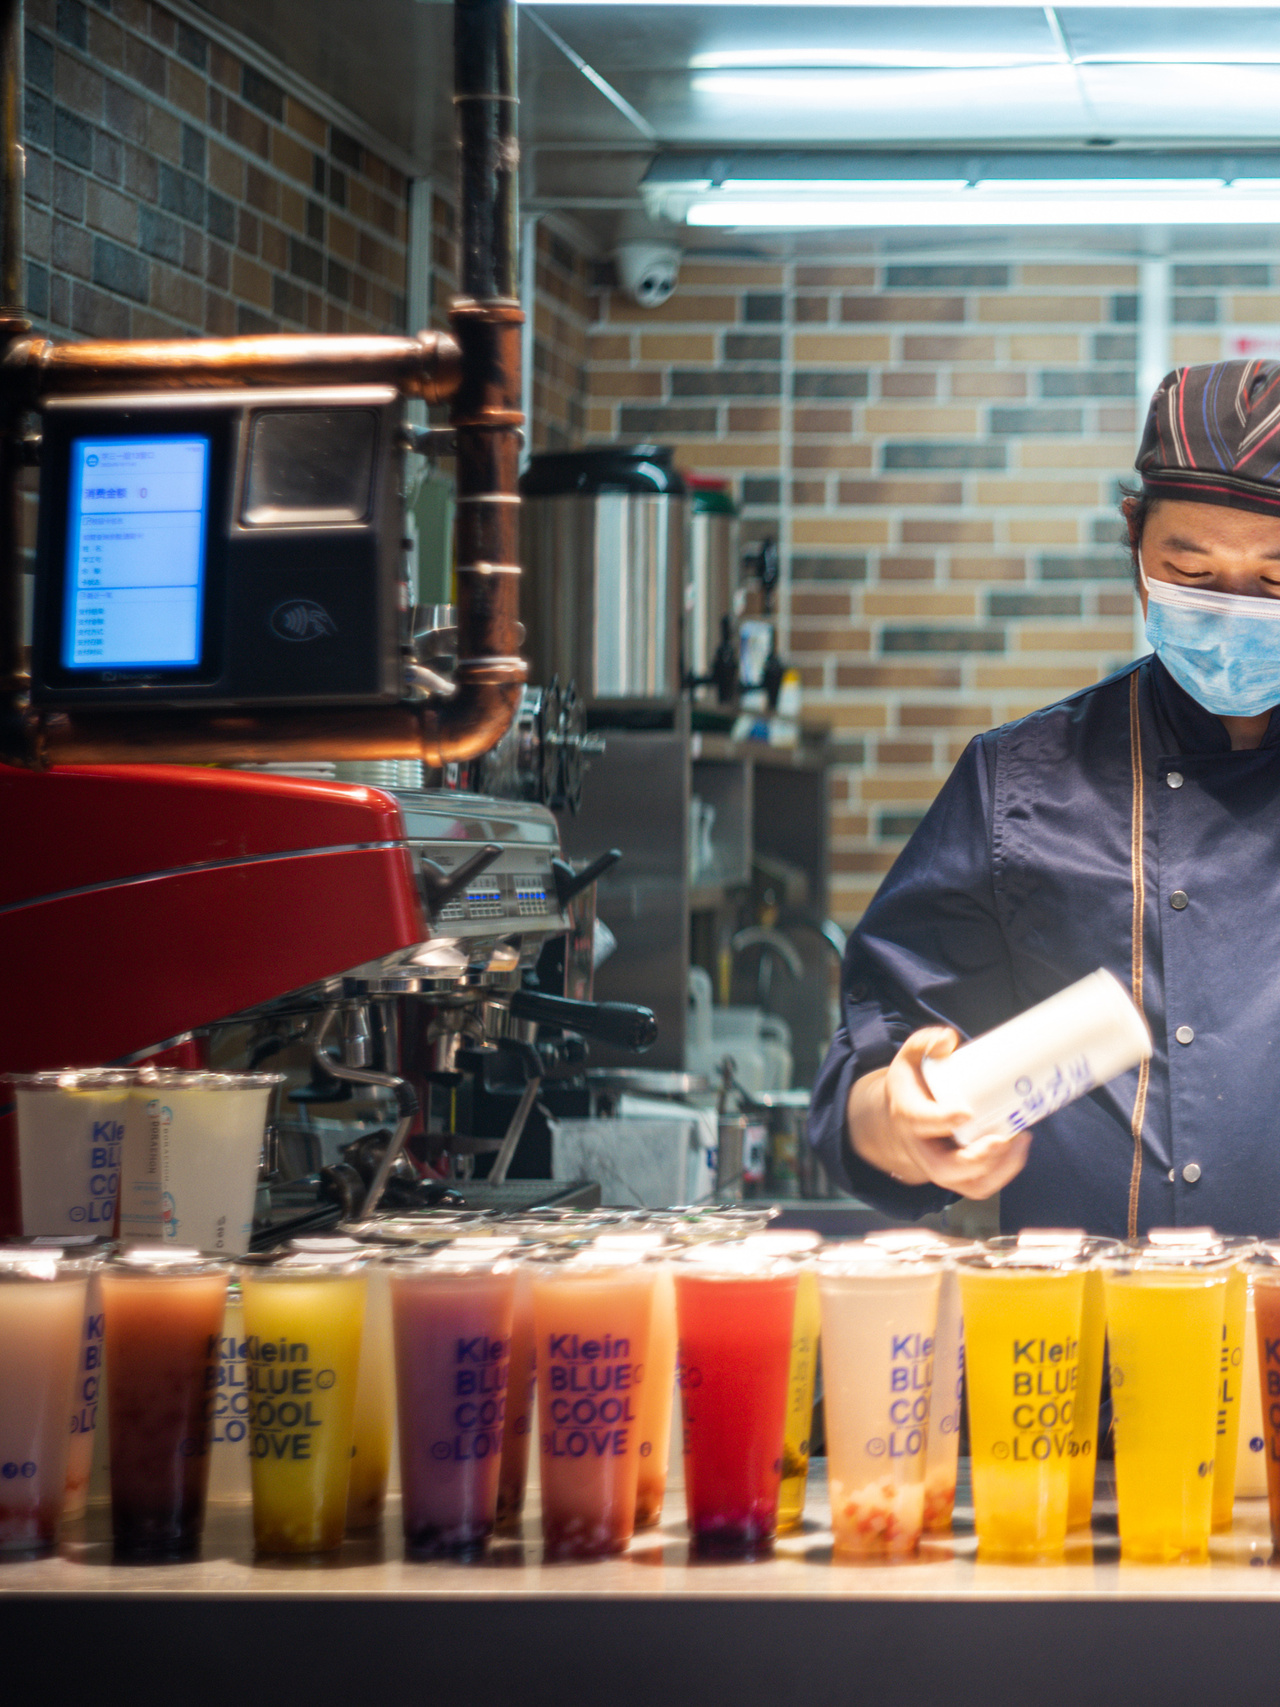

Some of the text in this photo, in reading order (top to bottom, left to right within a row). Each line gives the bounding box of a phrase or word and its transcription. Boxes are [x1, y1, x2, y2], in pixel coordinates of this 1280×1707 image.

[84, 487, 148, 500] 消费金额 0
[92, 1120, 126, 1143] Kle
[91, 1146, 122, 1169] BL
[89, 1172, 120, 1196] CO
[87, 1201, 116, 1223] LO
[457, 1336, 504, 1364] Kle
[550, 1333, 630, 1360] Klein
[891, 1332, 934, 1361] Kle
[551, 1364, 633, 1392] BLUE
[455, 1400, 499, 1428] CO
[551, 1396, 636, 1425] COOL
[889, 1395, 929, 1425] CO
[1013, 1400, 1073, 1429] COO
[211, 1420, 247, 1443] LO
[552, 1428, 629, 1458] LOVE
[888, 1428, 926, 1458] LO
[1012, 1430, 1073, 1461] LOV
[248, 1433, 312, 1460] OVE
